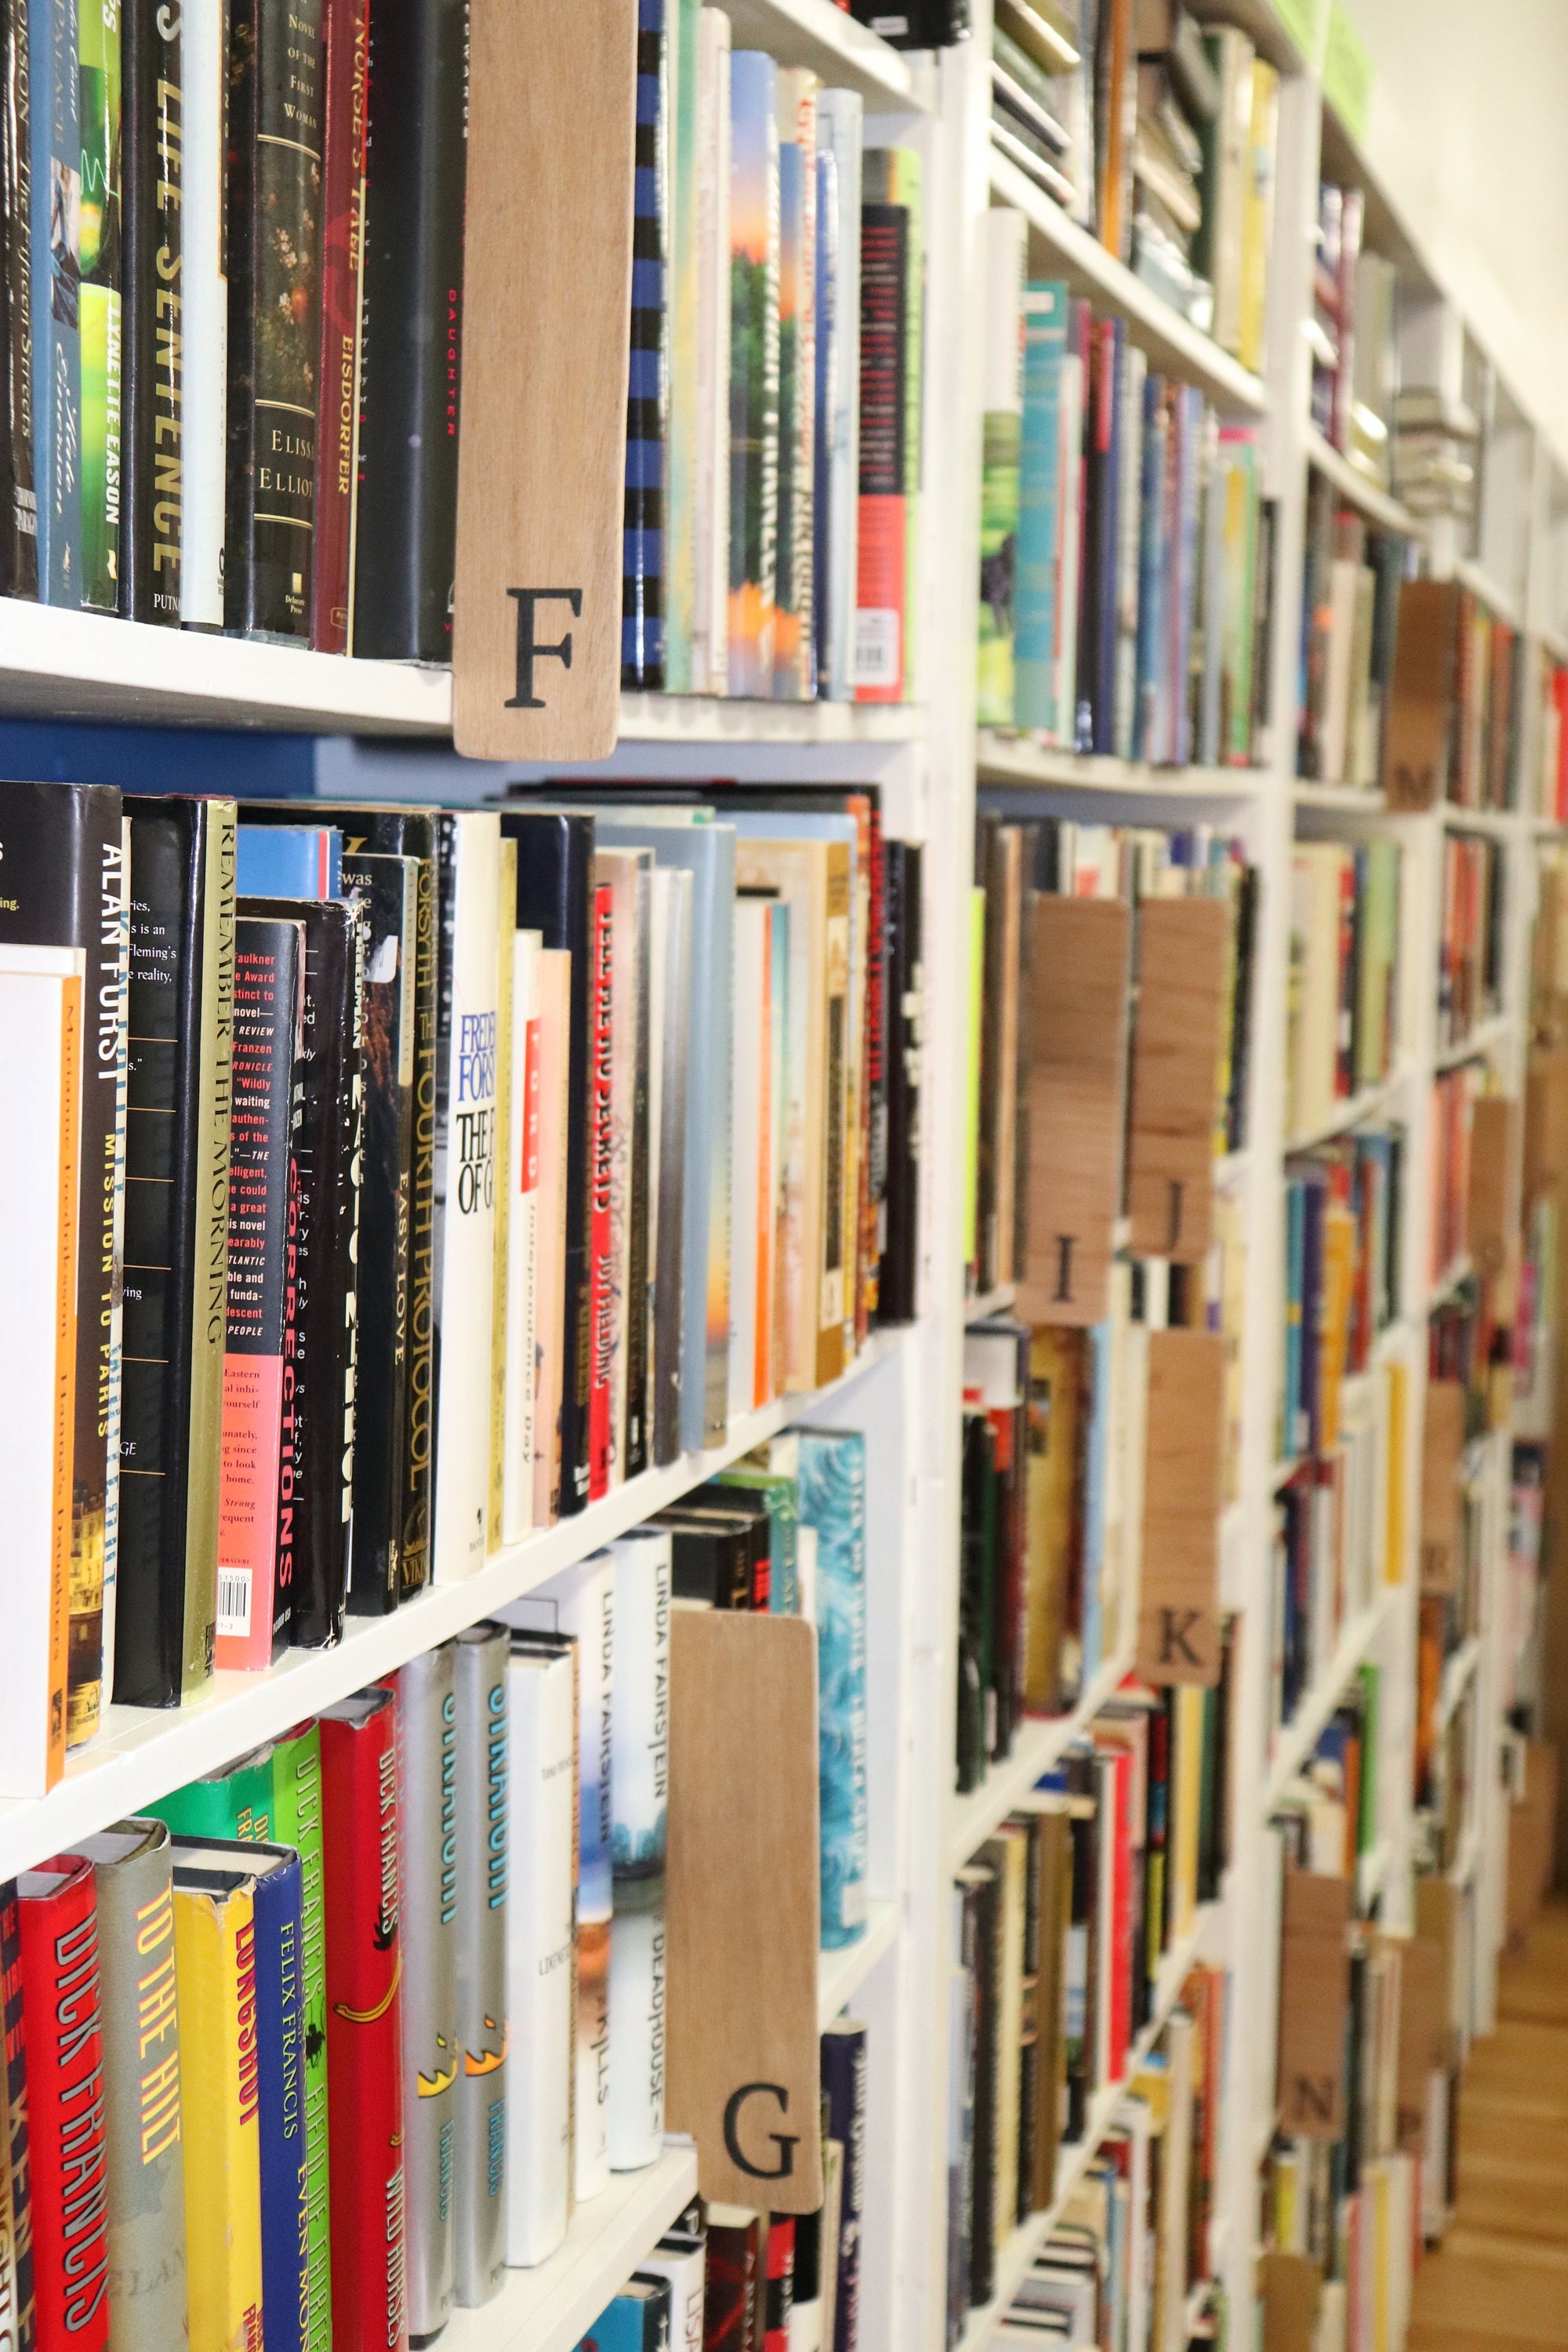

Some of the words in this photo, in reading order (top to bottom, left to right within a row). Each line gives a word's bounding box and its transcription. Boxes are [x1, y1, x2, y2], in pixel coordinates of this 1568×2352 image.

[20, 159, 31, 213] The
[157, 78, 182, 211] LIFE
[18, 220, 31, 326] Fifteen
[20, 332, 32, 439] Streets
[106, 305, 122, 427] LYNETTE
[446, 289, 457, 437] DAUGHTER
[153, 245, 183, 572] SENTENCE
[338, 334, 354, 495] EISDORFER
[104, 432, 121, 525] EASON
[154, 593, 181, 612] PUTNA
[504, 588, 583, 708] F
[100, 843, 122, 946] ALAN
[342, 873, 372, 886] was
[416, 858, 433, 988] FORSYTH
[140, 923, 151, 935] is
[154, 926, 166, 935] an
[216, 824, 235, 1040] REMEMBER
[234, 952, 275, 964] Faulkner
[98, 962, 121, 1080] FURST
[138, 969, 172, 984] reality,
[245, 971, 274, 982] Award
[263, 990, 274, 1001] to
[232, 1041, 272, 1054] Franzen
[239, 1025, 274, 1036] REVIEW
[214, 1060, 230, 1127] THE
[231, 1113, 269, 1124] authen-
[234, 1096, 270, 1109] waiting
[239, 1132, 249, 1142] of
[252, 1133, 269, 1143] the
[456, 1110, 488, 1164] THE
[416, 1048, 436, 1236] FOURTH
[101, 1133, 115, 1273] MISSION
[239, 1202, 267, 1216] great
[239, 1219, 266, 1232] novel
[240, 1185, 267, 1196] could
[397, 1170, 411, 1257] EASY
[457, 1161, 484, 1216] OF
[207, 1139, 227, 1345] MORNING
[245, 1272, 263, 1284] and
[1053, 1232, 1077, 1305] I
[100, 1289, 112, 1327] TO
[227, 1325, 263, 1337] PEOPLE
[230, 1289, 263, 1301] funda-
[394, 1272, 408, 1367] LOVE
[524, 1203, 536, 1403] Independence
[98, 1343, 111, 1438] PARIS
[223, 1368, 260, 1379] Eastern
[236, 1384, 260, 1394] inhi-
[279, 1156, 298, 1589] CORRECTIONS
[410, 1247, 434, 1492] PROTOCOL
[223, 1459, 233, 1468] to
[234, 1459, 256, 1469] look
[226, 1473, 255, 1485] home.
[233, 1445, 257, 1455] since
[522, 1416, 532, 1465] Day
[224, 1497, 256, 1510] Strong
[601, 1591, 614, 1682] LINDA
[653, 1563, 668, 1648] LINDA
[1158, 1607, 1203, 1668] K
[597, 1690, 613, 1845] FAIRSTEIN
[647, 1656, 668, 1800] FAIRSTEIN
[296, 1753, 319, 1843] DICK
[378, 1748, 395, 1817] DICK
[135, 1875, 174, 1955] TO
[380, 1816, 398, 1935] FRANCIS
[280, 1918, 296, 2009] FELIX
[301, 1848, 323, 2002] FRANCIS
[54, 1907, 102, 2068] DICK
[136, 1945, 177, 2060] THE
[235, 1923, 260, 2126] LONGSHOT
[647, 1933, 666, 2108] DEADHOUSE
[139, 2050, 182, 2166] HILT
[281, 2008, 299, 2140] FRANCIS
[307, 2081, 328, 2178] FIELD
[723, 2082, 800, 2181] G
[59, 2058, 110, 2333] FRANCIS
[297, 2161, 308, 2256] EVEN
[307, 2181, 328, 2224] OF
[384, 2164, 404, 2242] WILD
[386, 2237, 406, 2349] HORSES
